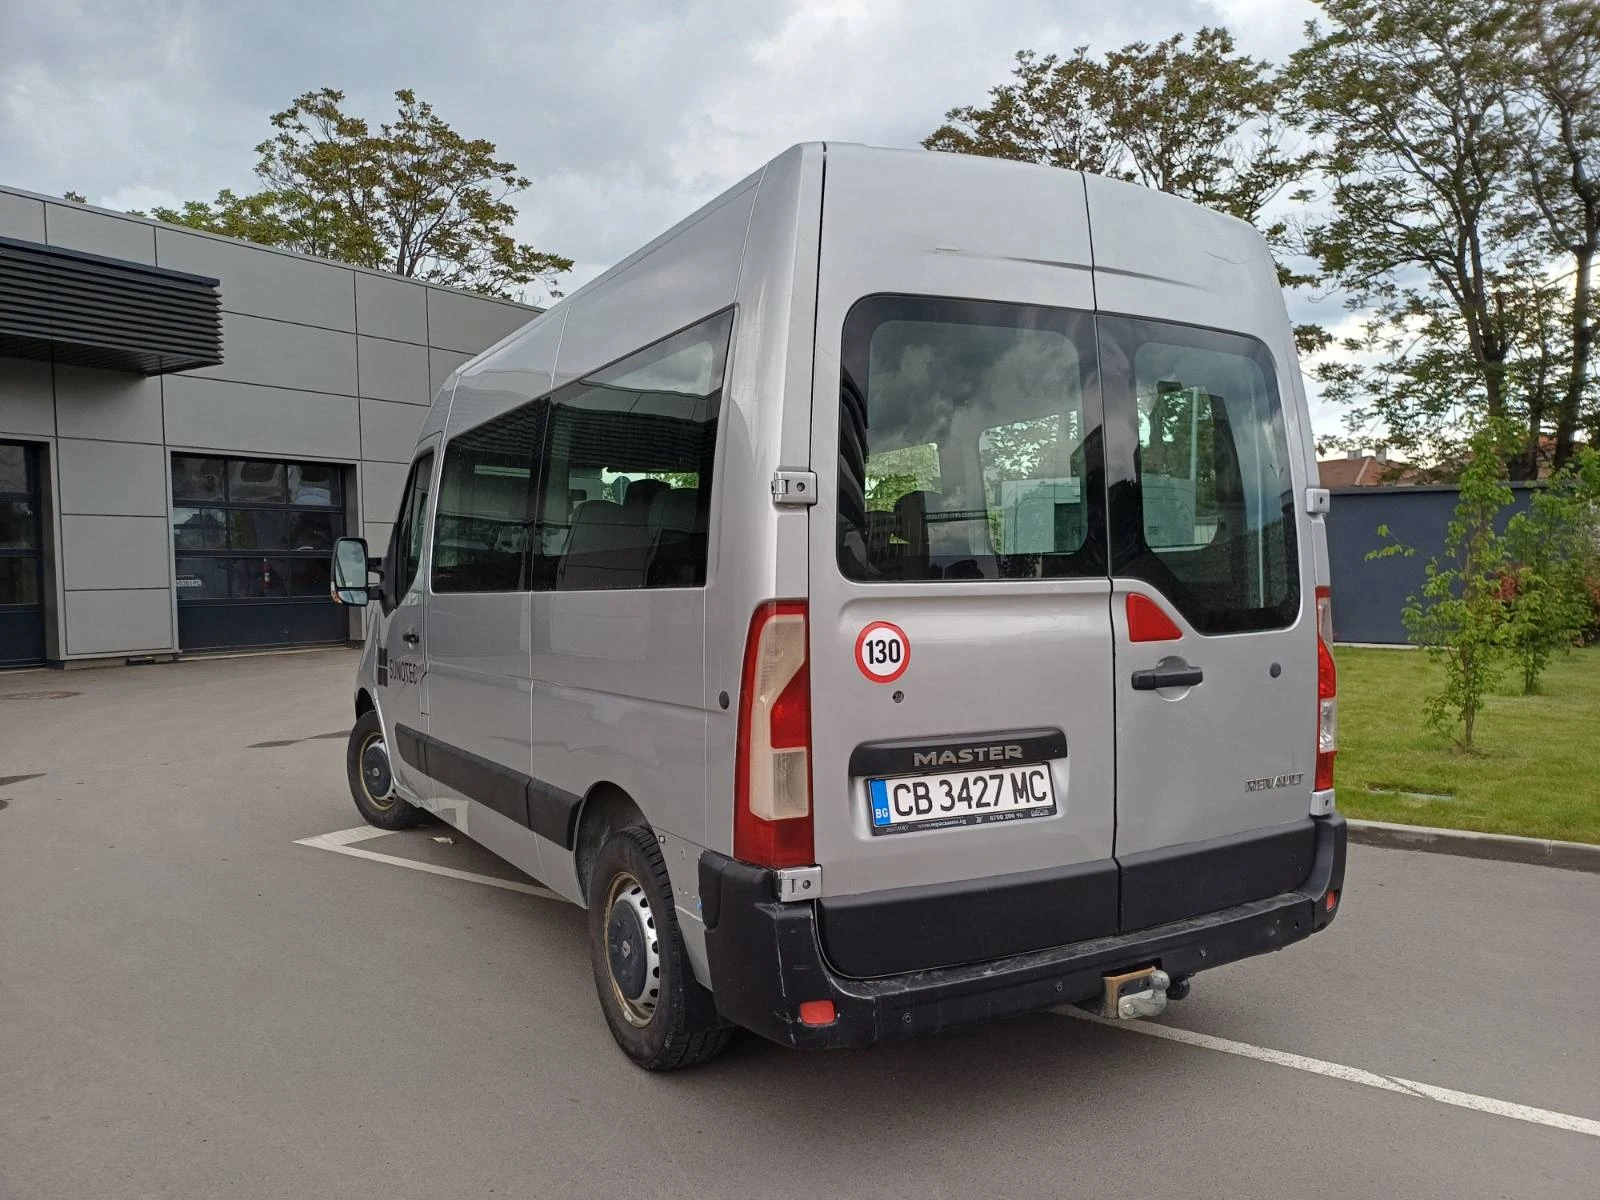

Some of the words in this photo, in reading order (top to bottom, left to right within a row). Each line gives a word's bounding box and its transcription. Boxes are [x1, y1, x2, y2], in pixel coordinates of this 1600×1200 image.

[866, 639, 901, 664] 130
[913, 745, 1023, 767] MASTER
[893, 781, 933, 816] CB
[939, 773, 1004, 812] 3427
[1010, 770, 1047, 804] MC
[1245, 772, 1304, 792] RENAULT
[875, 807, 889, 819] BG
